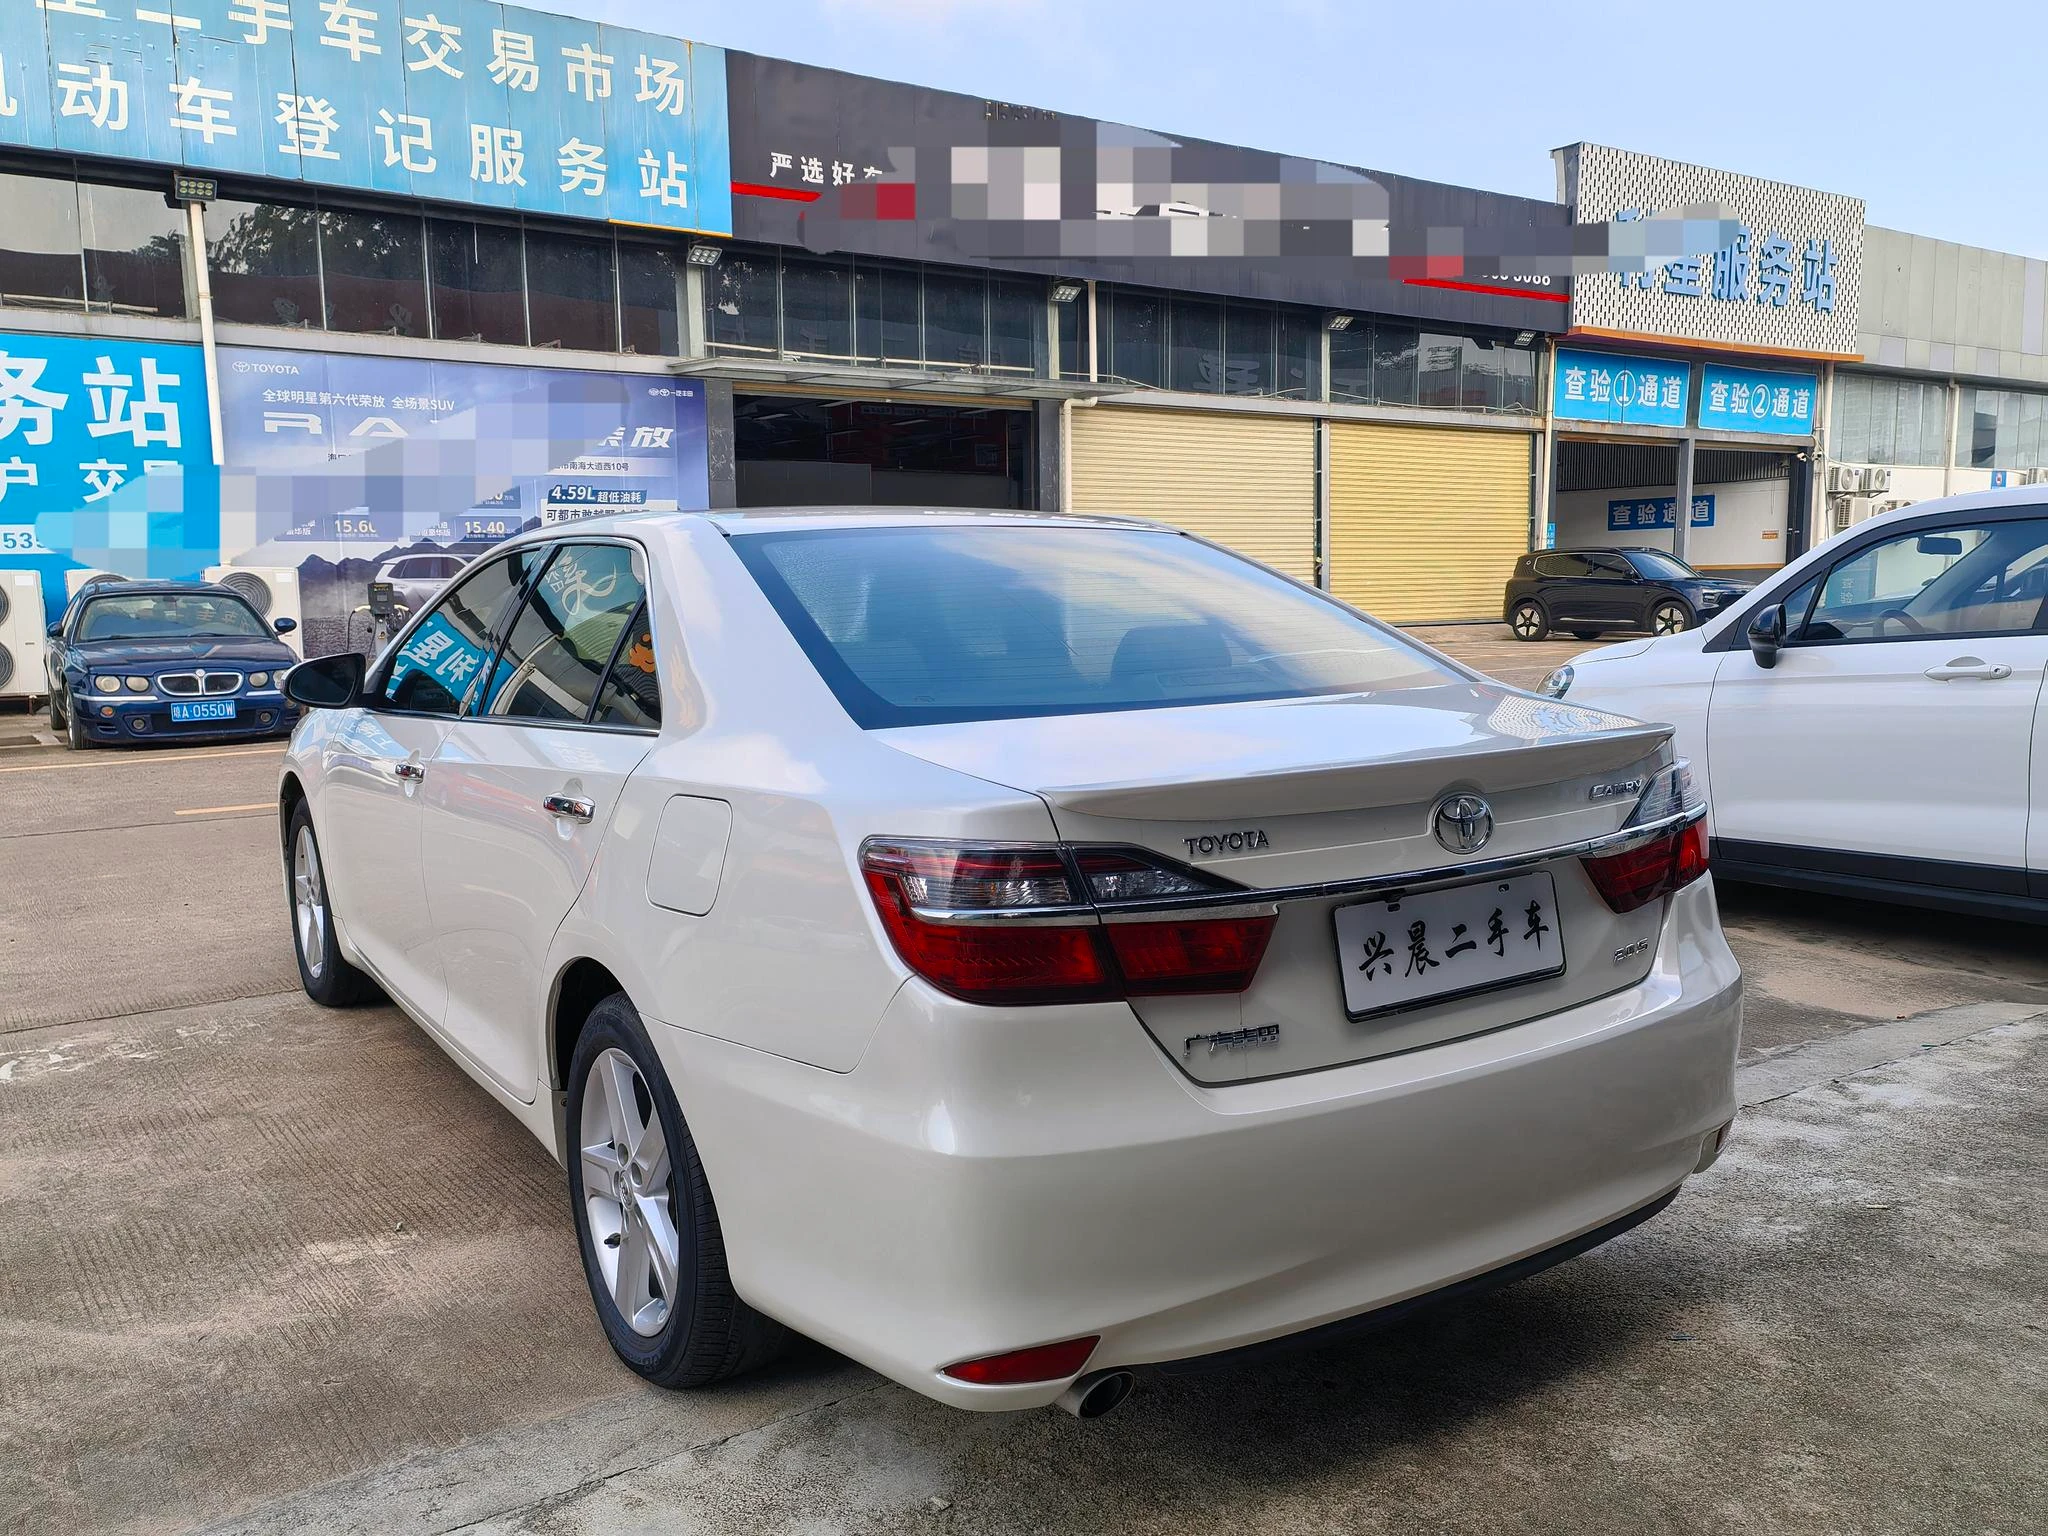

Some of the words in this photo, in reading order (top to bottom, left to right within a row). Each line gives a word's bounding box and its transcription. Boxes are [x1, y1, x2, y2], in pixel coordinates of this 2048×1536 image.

[36, 0, 686, 117] 二手车交易市场
[251, 363, 299, 375] TOYOTA
[262, 388, 386, 409] 全球明星第六代荣放
[551, 485, 595, 500] 4.59L
[597, 491, 642, 503] 超低油耗
[464, 521, 505, 534] 15.40
[1589, 779, 1643, 800] CAMRY
[1182, 829, 1270, 857] TOYOTA
[1358, 898, 1550, 982] 兴晨二手车
